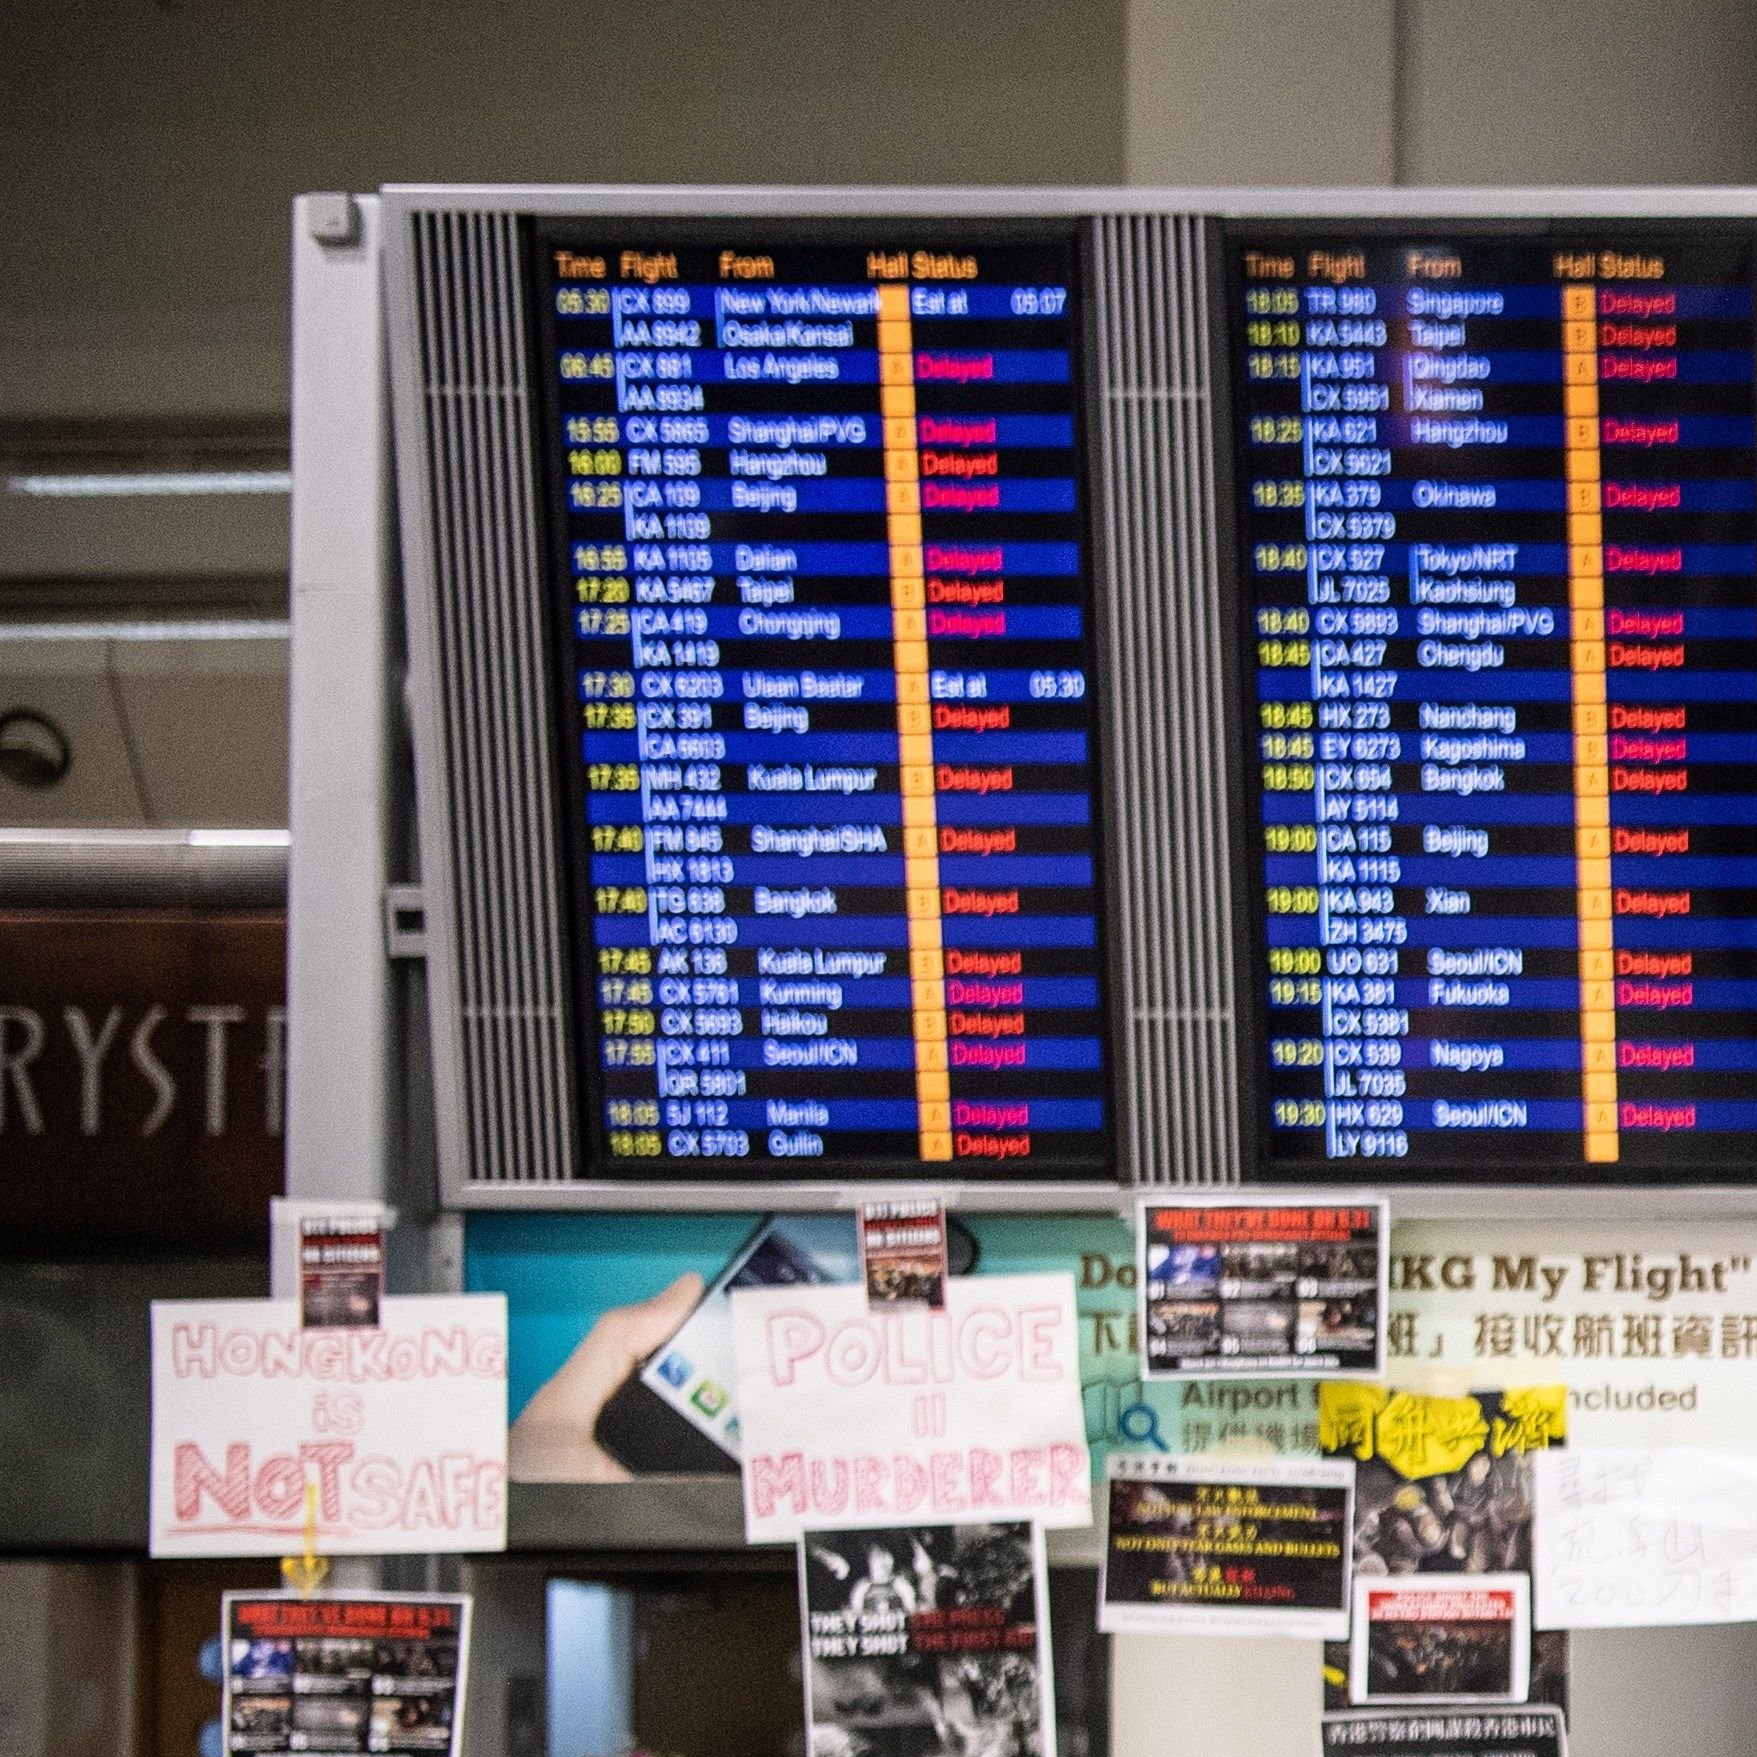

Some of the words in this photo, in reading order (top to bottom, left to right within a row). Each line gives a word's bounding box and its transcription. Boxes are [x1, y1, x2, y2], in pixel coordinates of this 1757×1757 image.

[763, 354, 840, 384] Angeles
[1419, 706, 1516, 735] Nanchang
[1611, 708, 1685, 733] Delayed
[1421, 737, 1525, 764] Kagoshima
[1421, 766, 1505, 796] Bangkok
[1423, 829, 1489, 857] Beijing
[1425, 890, 1471, 914] Xian
[1429, 981, 1509, 1006] Fukuoka
[1431, 1042, 1504, 1071] Nagoya
[1433, 1103, 1527, 1129] Seoul/ICN
[1492, 1256, 1569, 1301] My
[1582, 1254, 1752, 1301] Flight"
[765, 1300, 1065, 1388] POLICE
[1181, 1381, 1310, 1421] Airport
[1570, 1383, 1698, 1413] ncluded
[351, 1452, 507, 1533] SAFE
[748, 1441, 1094, 1521] MURDERER
[811, 1634, 859, 1658] THEY
